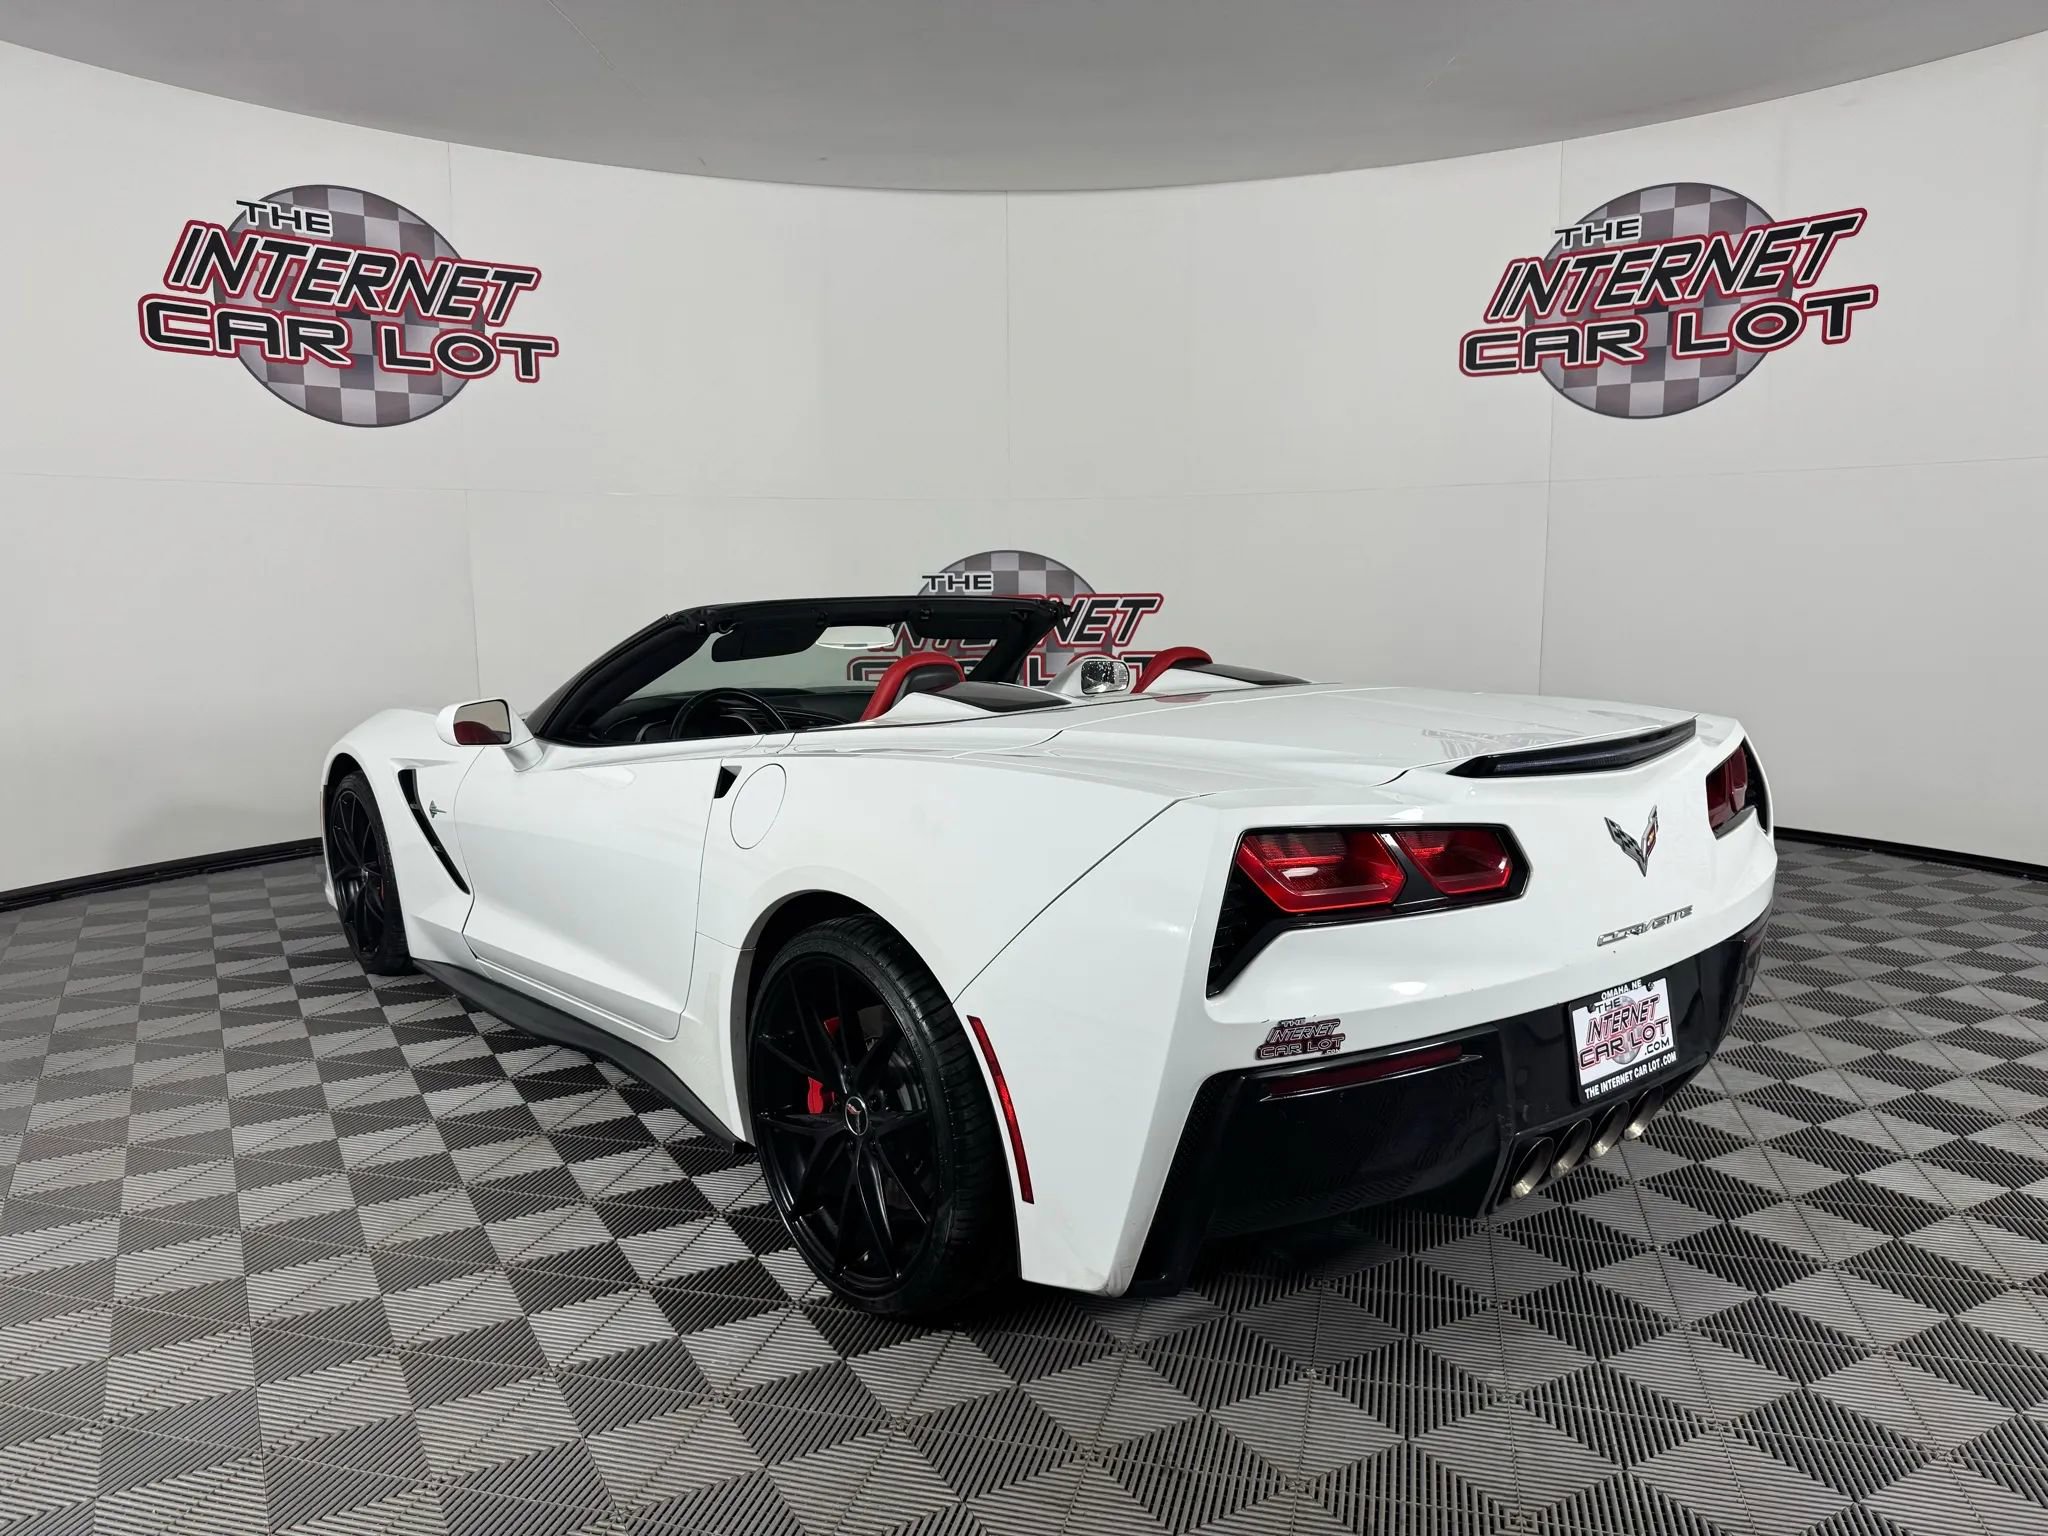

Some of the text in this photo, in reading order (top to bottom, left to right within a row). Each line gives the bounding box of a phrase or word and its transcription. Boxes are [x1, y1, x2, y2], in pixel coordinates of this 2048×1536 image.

[236, 200, 332, 236] THE
[1554, 216, 1642, 247] THE
[164, 221, 541, 326] INTERNET
[1484, 209, 1867, 323] INTERNET
[139, 294, 558, 382] CAR LOT
[1460, 285, 1877, 376] CAR LOT
[921, 572, 994, 592] THE
[1631, 979, 1642, 990] NE
[1587, 995, 1660, 1044] INTERNET
[1595, 997, 1620, 1013] THE
[1268, 1021, 1340, 1043] INTERNET
[1281, 1019, 1306, 1028] THE
[1260, 1037, 1345, 1058] CAR LOT
[1579, 1017, 1669, 1070] CAR LOT
[1645, 1037, 1670, 1055] .COM
[1584, 1084, 1600, 1099] THE
[1600, 1070, 1633, 1093] INTERNET
[1634, 1064, 1648, 1078] CAR
